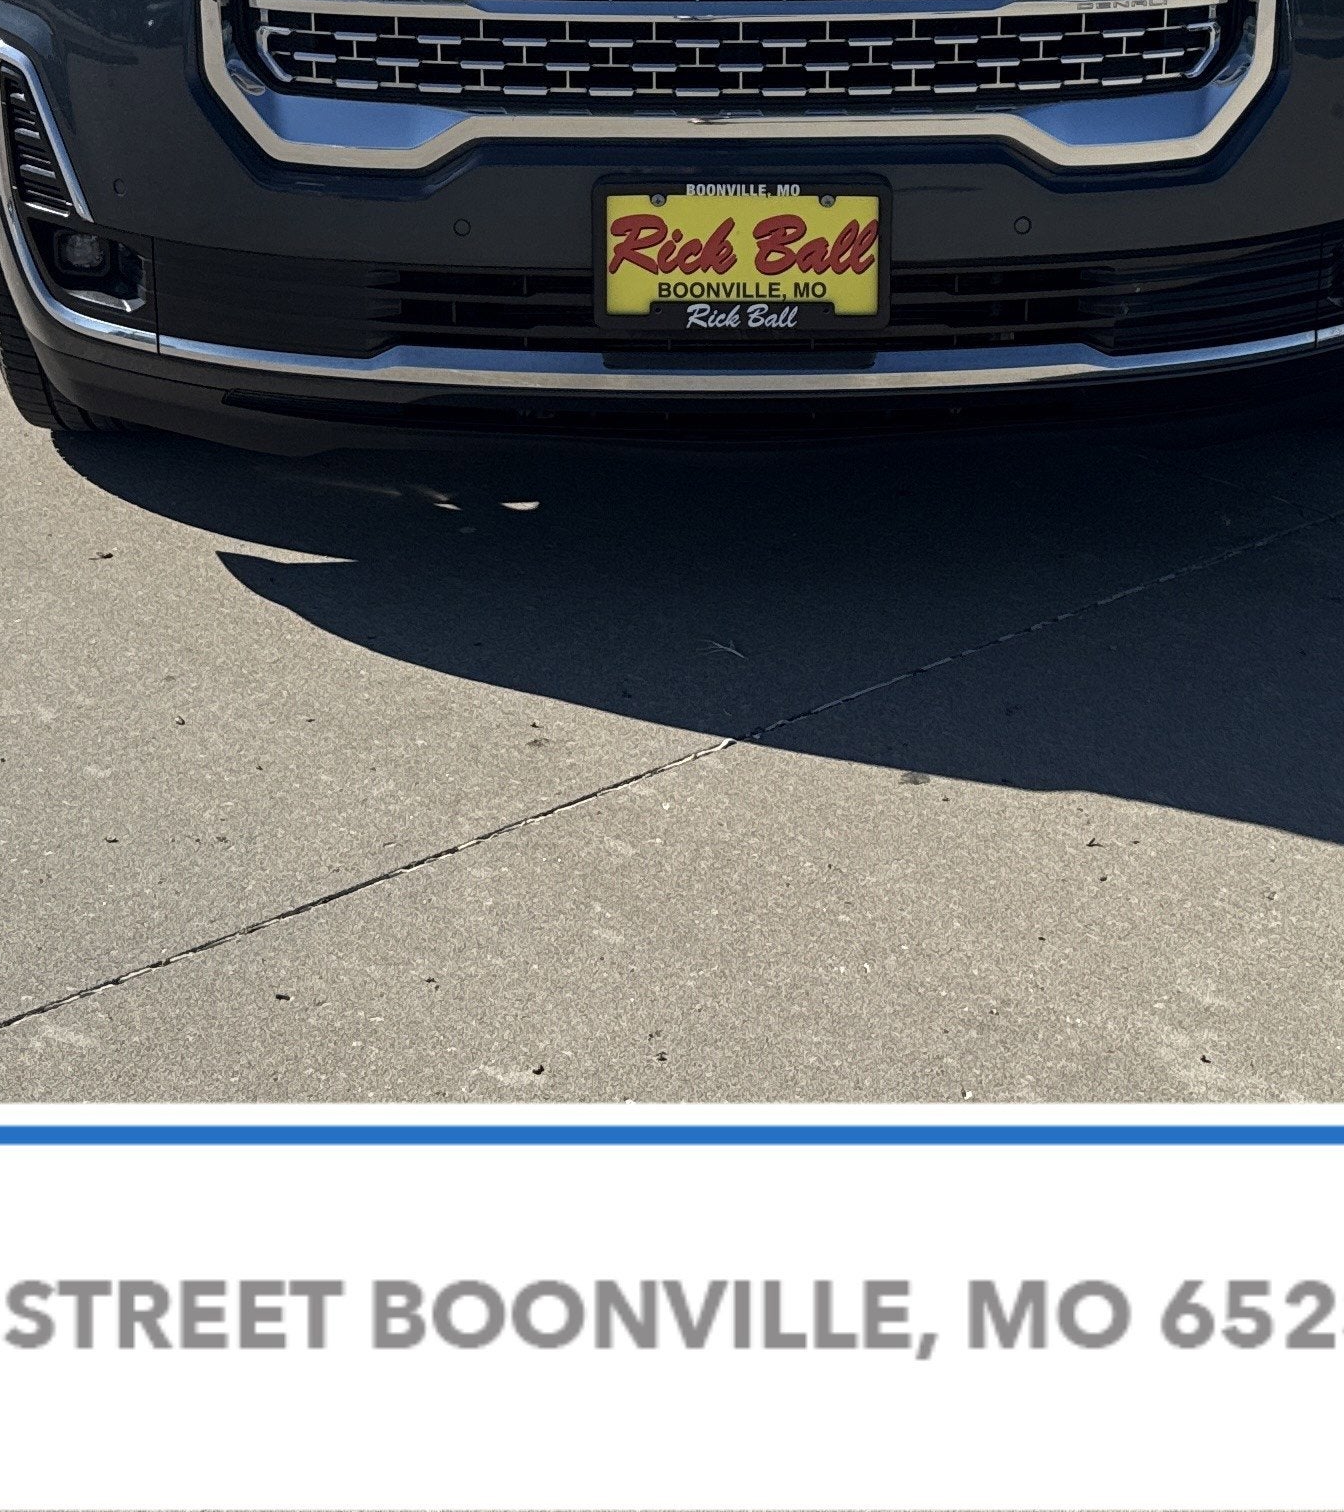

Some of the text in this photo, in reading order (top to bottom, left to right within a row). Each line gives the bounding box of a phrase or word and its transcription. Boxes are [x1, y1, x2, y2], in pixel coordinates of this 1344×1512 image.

[686, 183, 801, 198] BOONVILLE, MO
[608, 213, 879, 275] Rick Ball
[657, 281, 827, 302] BOONVILLE, MO
[686, 303, 797, 329] Rick Ball
